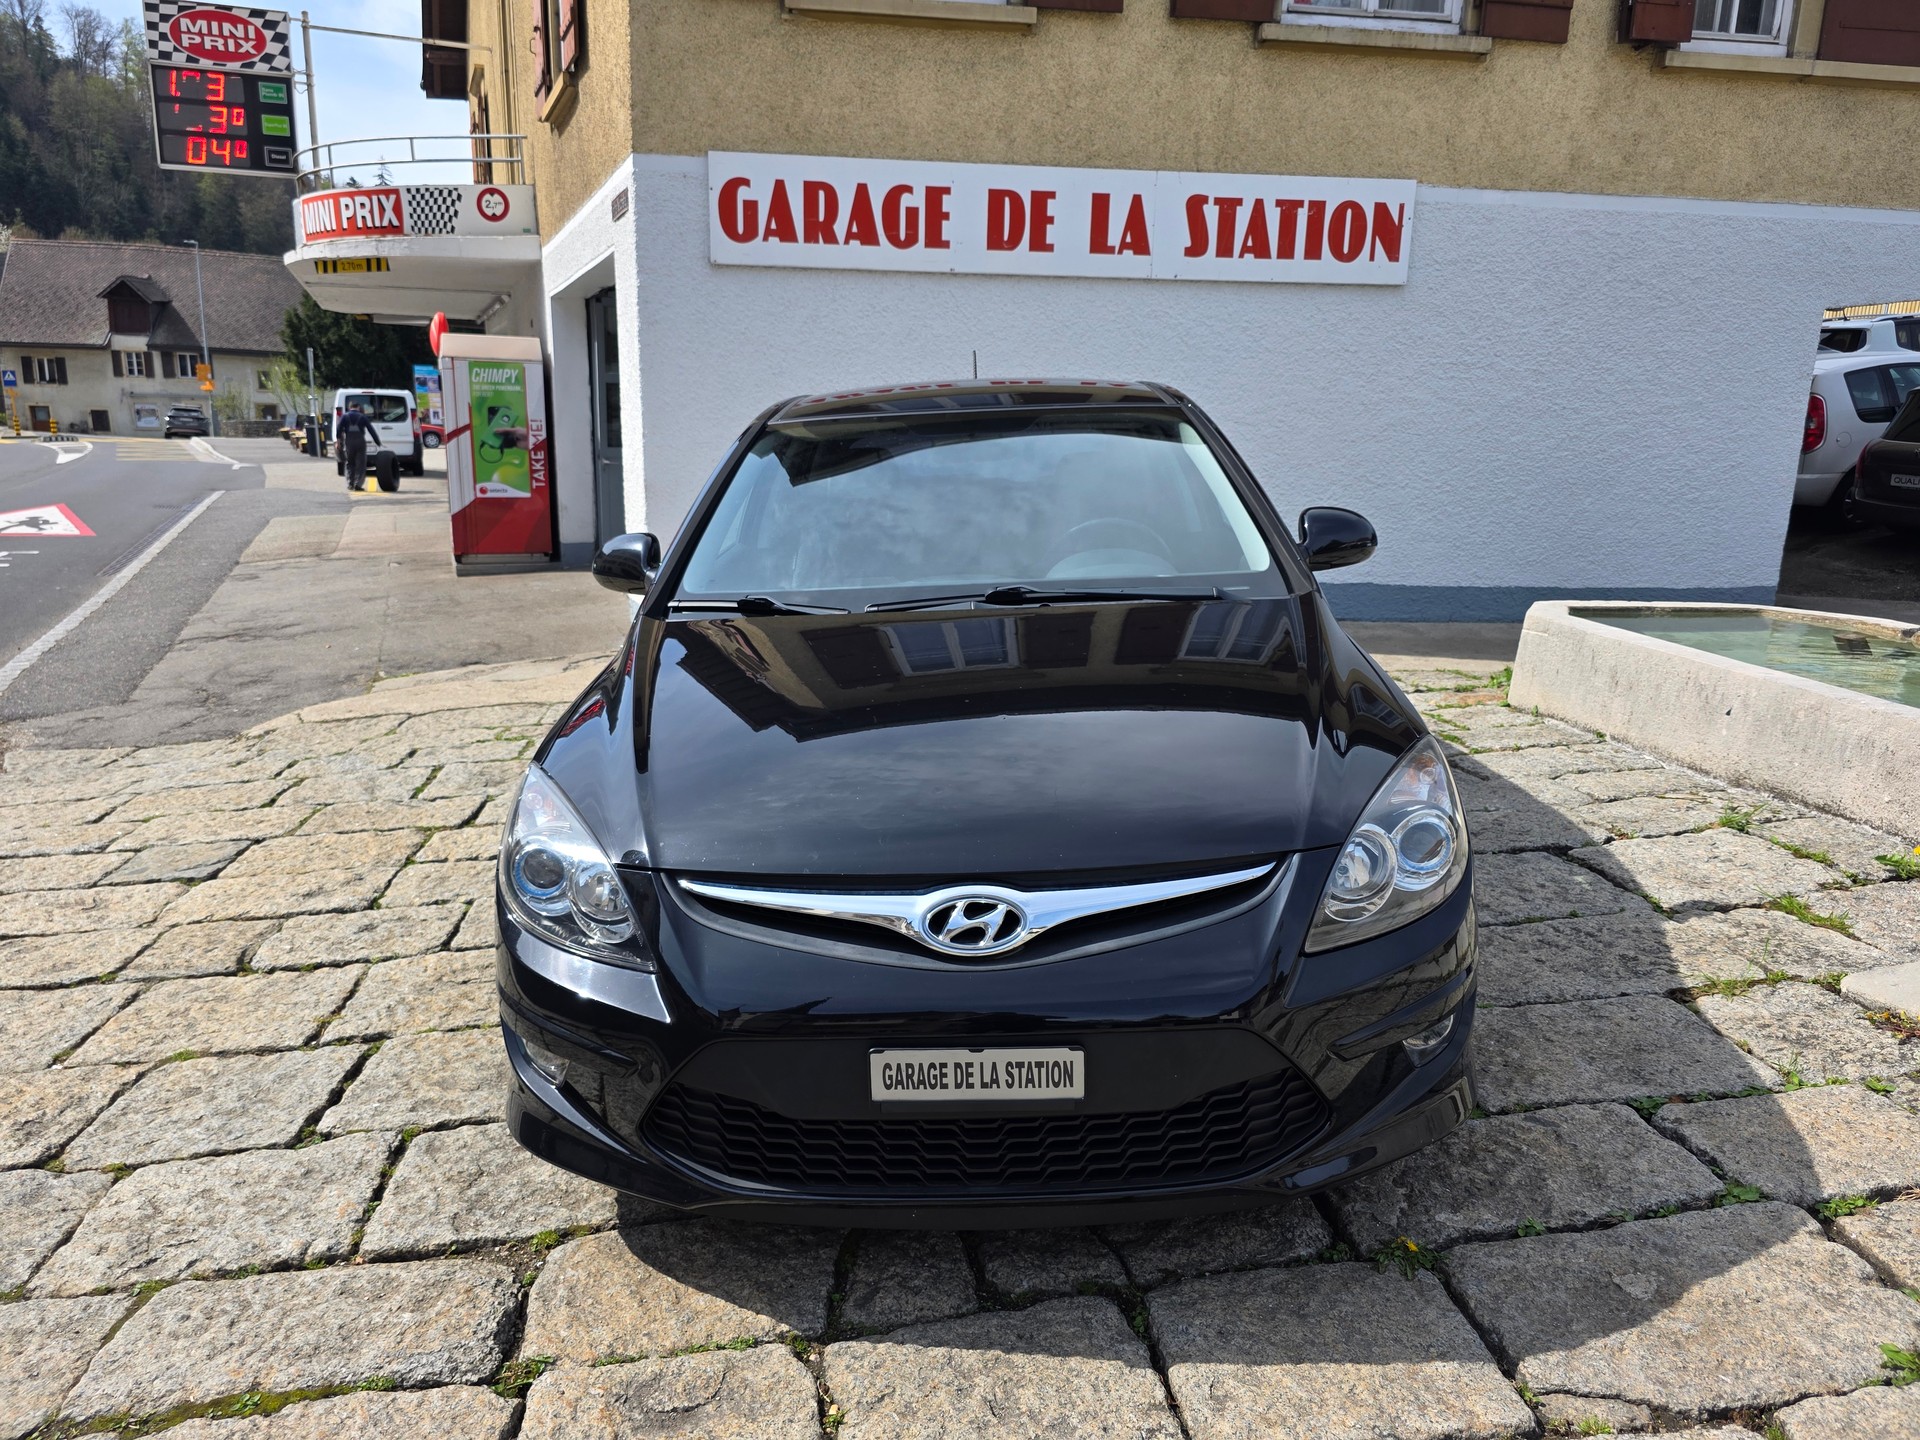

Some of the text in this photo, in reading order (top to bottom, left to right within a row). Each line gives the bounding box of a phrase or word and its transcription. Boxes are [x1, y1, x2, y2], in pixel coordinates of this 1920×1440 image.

[179, 17, 256, 39] MINI
[181, 33, 258, 55] PRIX
[303, 193, 400, 235] MINI PRIX
[717, 176, 1405, 263] GARAGE DE LA STATION
[472, 367, 519, 384] CHIMPY
[530, 419, 546, 489] TAKE ME!
[882, 1060, 1074, 1091] GARAGE DE LA STATION
